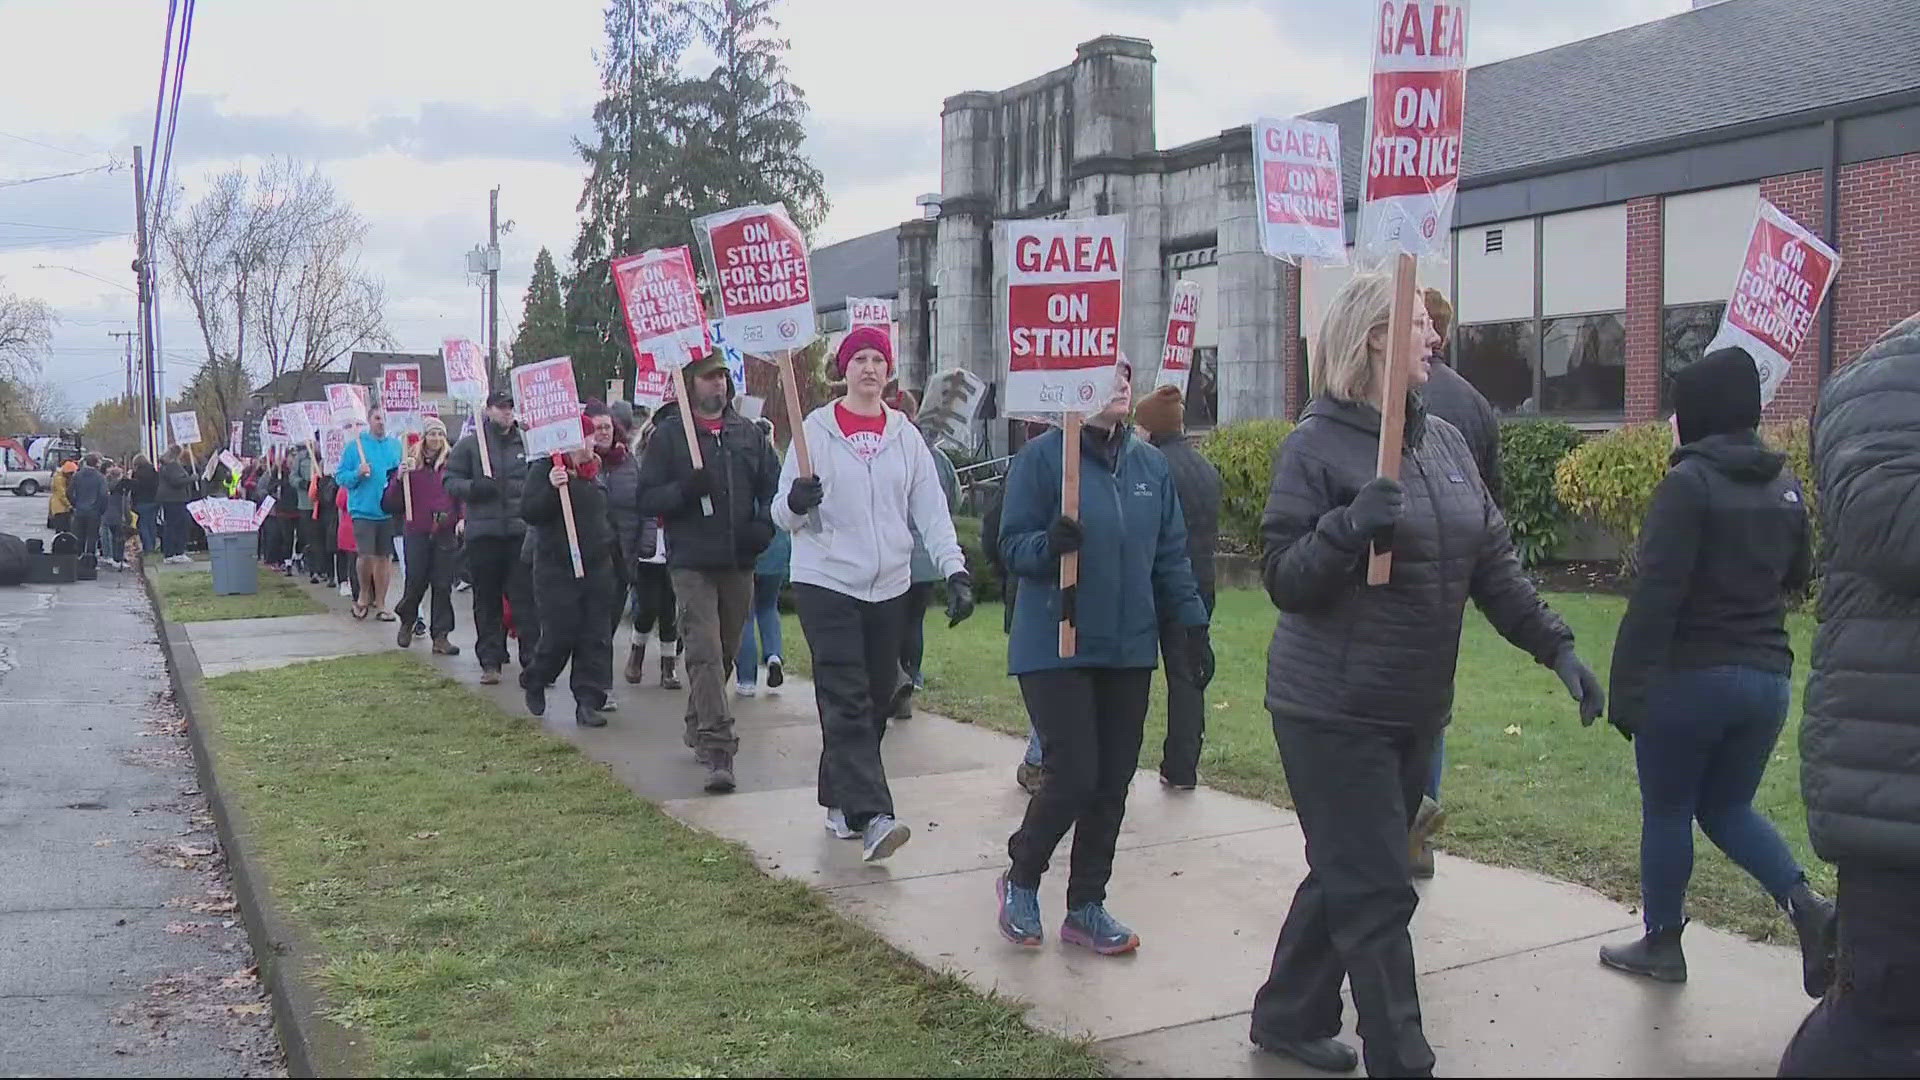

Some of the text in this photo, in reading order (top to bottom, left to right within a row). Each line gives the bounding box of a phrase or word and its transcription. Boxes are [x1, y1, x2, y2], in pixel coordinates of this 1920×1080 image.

[1381, 1, 1464, 57] GAEA
[1393, 87, 1441, 129] ON
[1265, 128, 1333, 161] GAEA
[1370, 136, 1459, 178] STRIKE
[1288, 168, 1321, 193] ON
[1267, 192, 1337, 220] STRIKE
[742, 222, 770, 244] ON
[727, 240, 794, 267] STRIKE
[1015, 235, 1117, 272] GAEA
[1781, 239, 1806, 271] ON
[643, 265, 664, 282] ON
[720, 258, 806, 288] FOR SAFE
[1757, 252, 1812, 306] STRIKE
[632, 278, 680, 302] STRIKE
[724, 278, 806, 307] SCHOOLS
[1735, 269, 1811, 331] FOR SAFE
[626, 290, 693, 320] FOR SAFE
[853, 303, 889, 322] GAEA
[1048, 292, 1088, 323] ON
[632, 312, 698, 335] SCHOOLS
[1732, 292, 1797, 353] SCHOOLS
[1012, 327, 1116, 357] STRIKE
[1165, 346, 1190, 364] STR
[388, 381, 416, 391] STRIKE
[396, 371, 407, 380] ON
[535, 369, 551, 382] ON
[637, 381, 664, 393] STRI
[386, 391, 400, 401] FOR
[525, 380, 565, 401] STRIKE
[525, 391, 571, 416] FOR OUR
[386, 400, 418, 409] SCHOOLS
